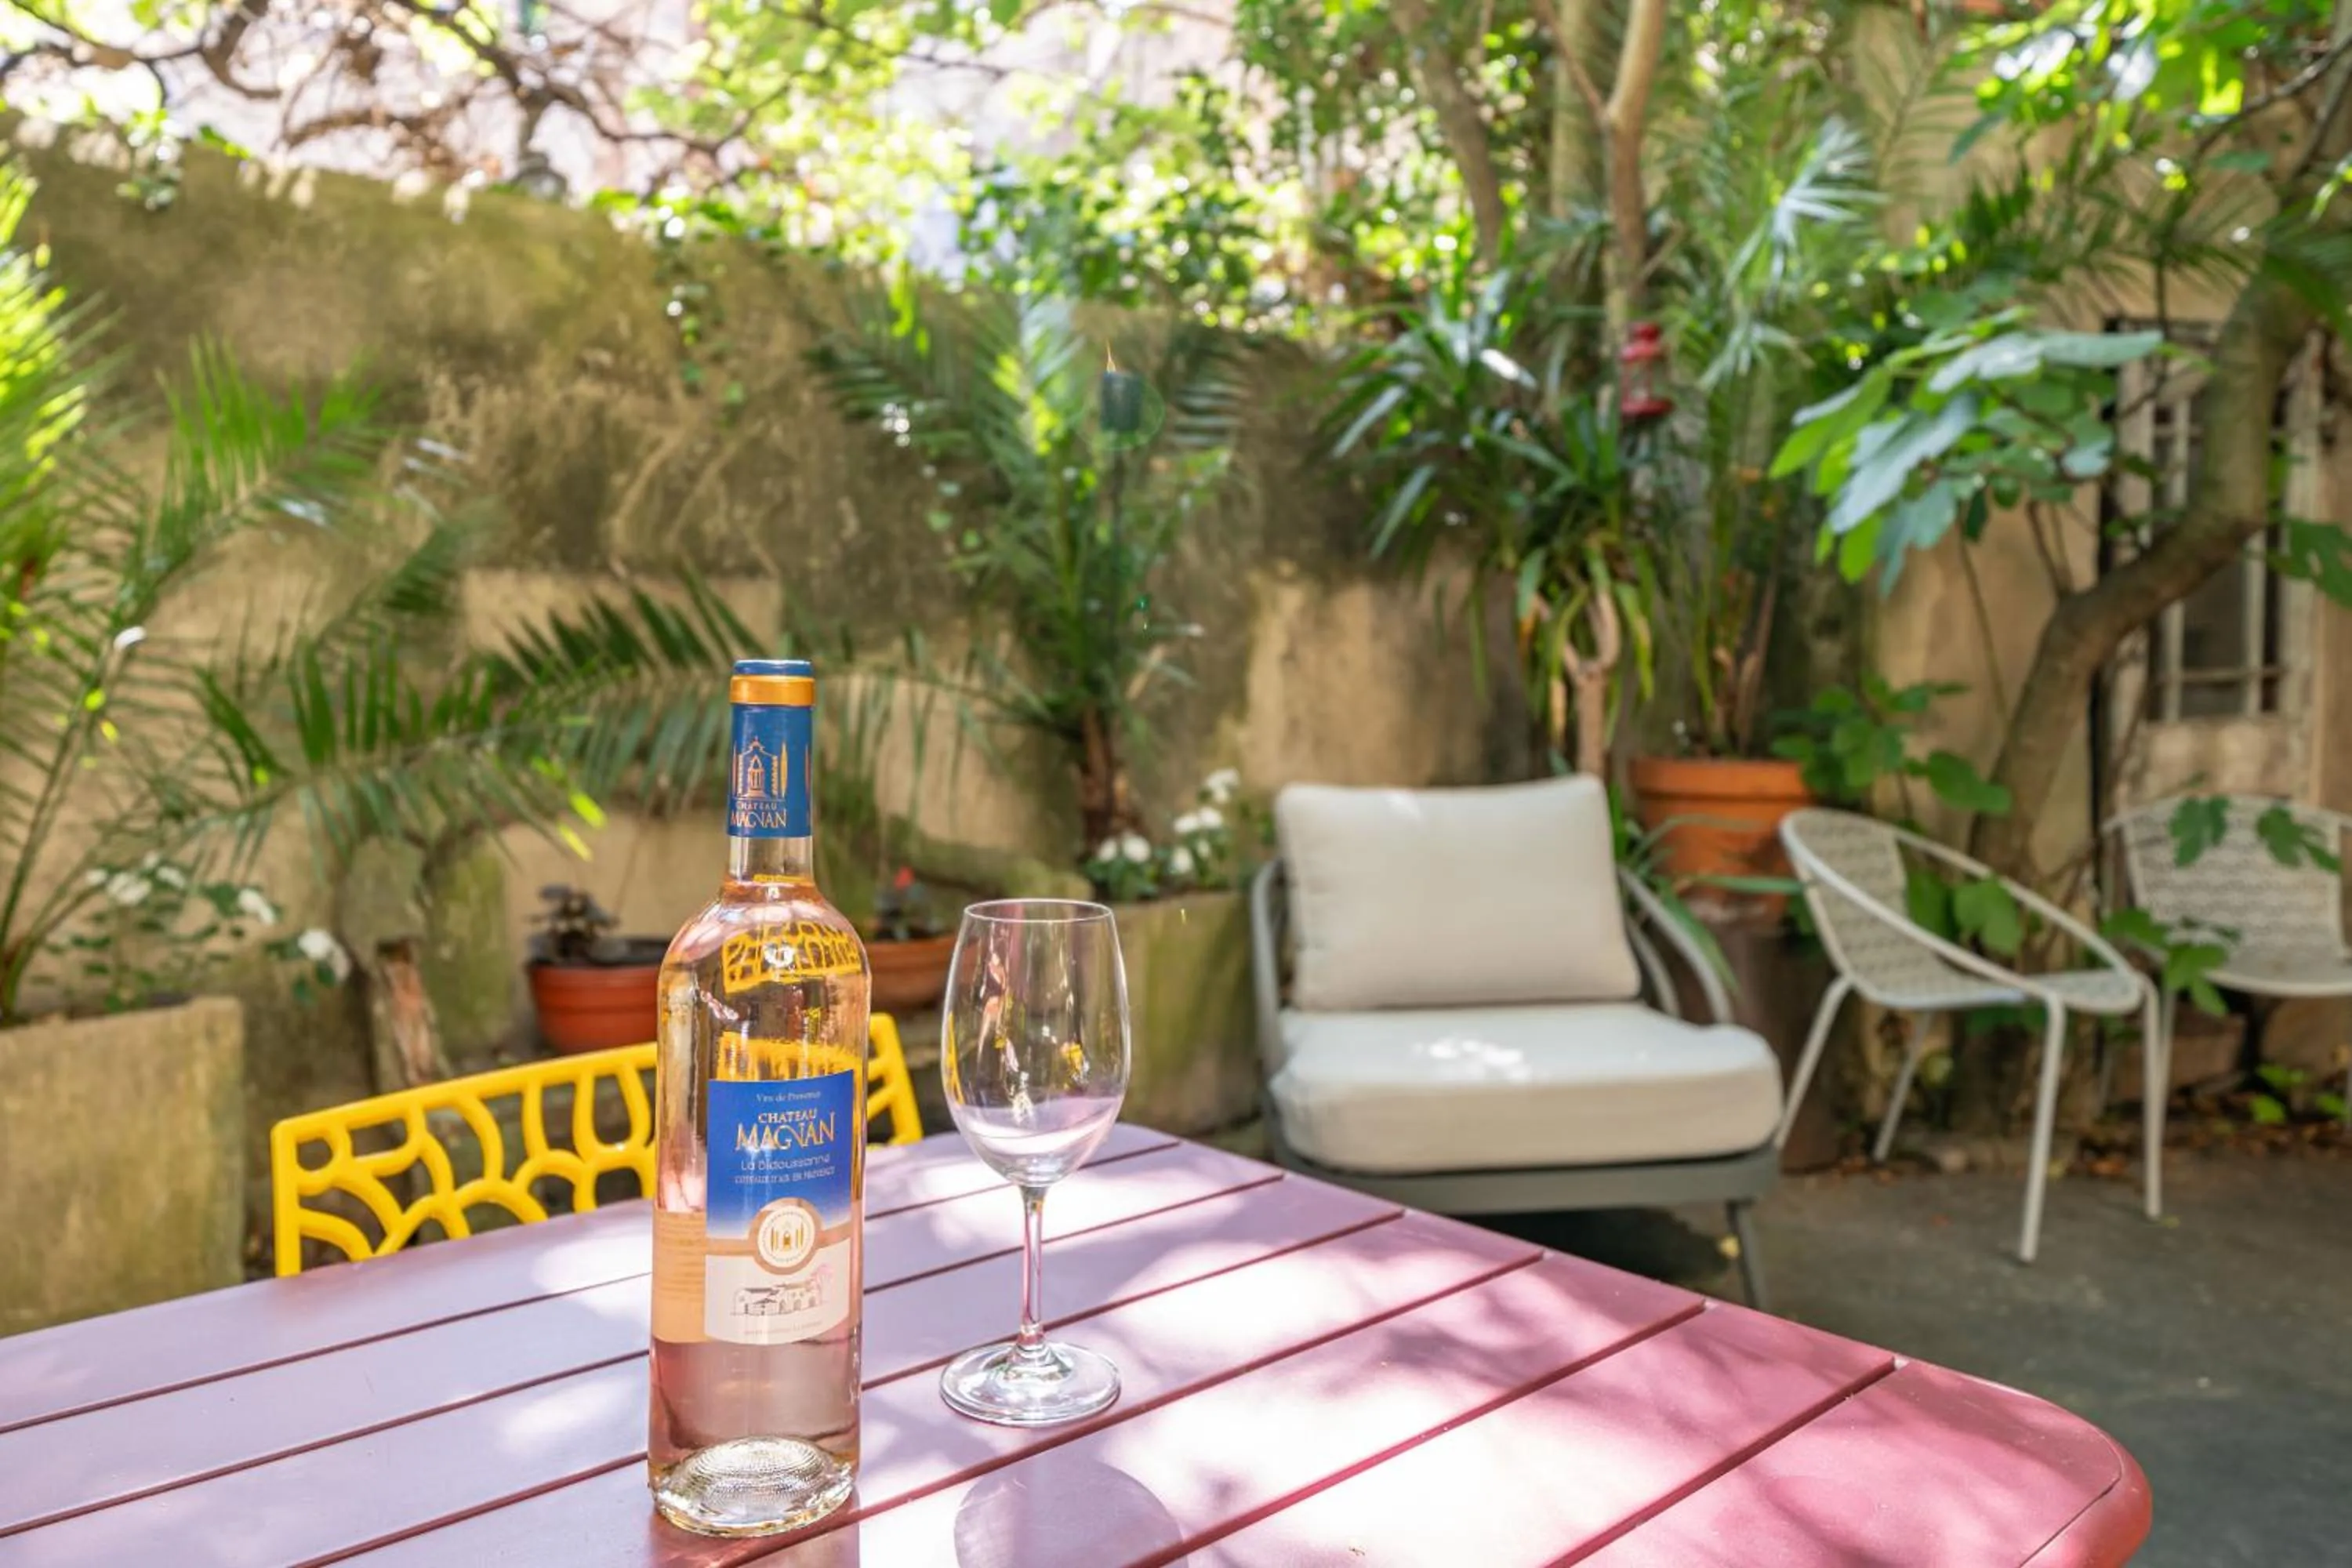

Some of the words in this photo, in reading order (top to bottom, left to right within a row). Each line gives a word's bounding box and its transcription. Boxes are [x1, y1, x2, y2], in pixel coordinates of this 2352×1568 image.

[731, 808, 786, 828] MAGNAN
[758, 1108, 817, 1123] CHATEAU
[735, 1112, 835, 1151] MAGNAN
